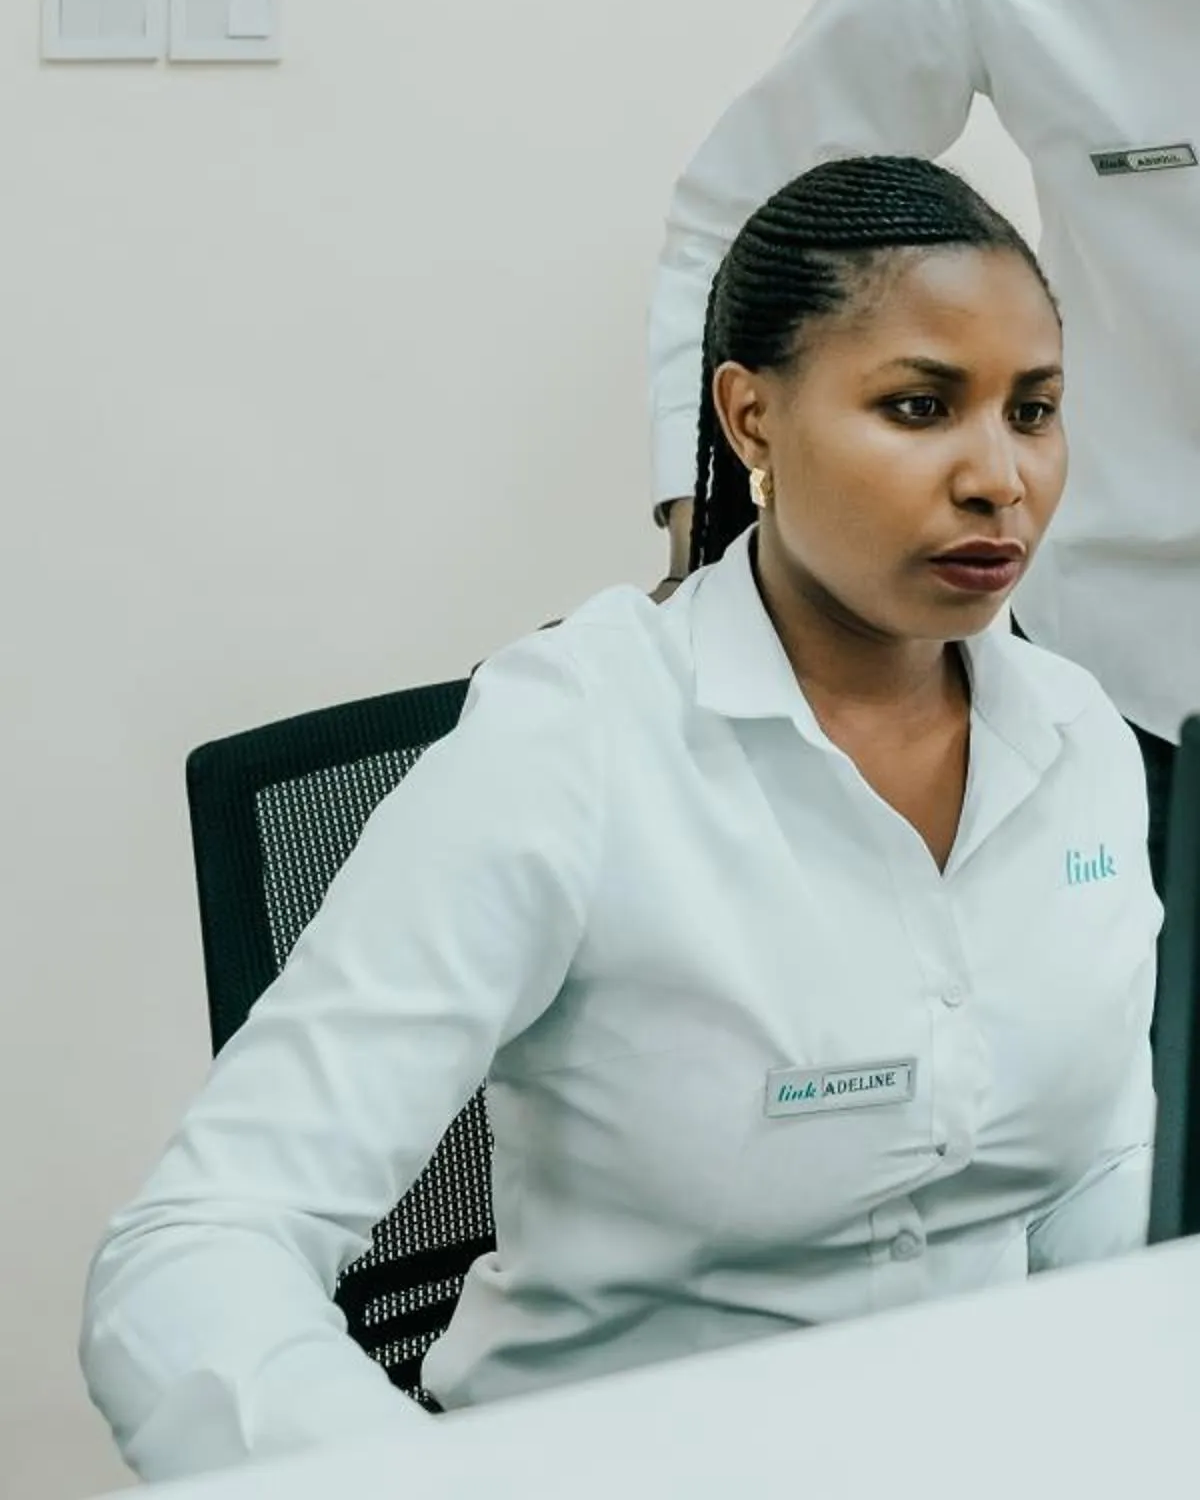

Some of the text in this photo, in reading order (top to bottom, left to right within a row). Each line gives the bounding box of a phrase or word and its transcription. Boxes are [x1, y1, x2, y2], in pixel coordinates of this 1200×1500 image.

[1066, 843, 1116, 885] link
[777, 1071, 896, 1103] link ADELINE
